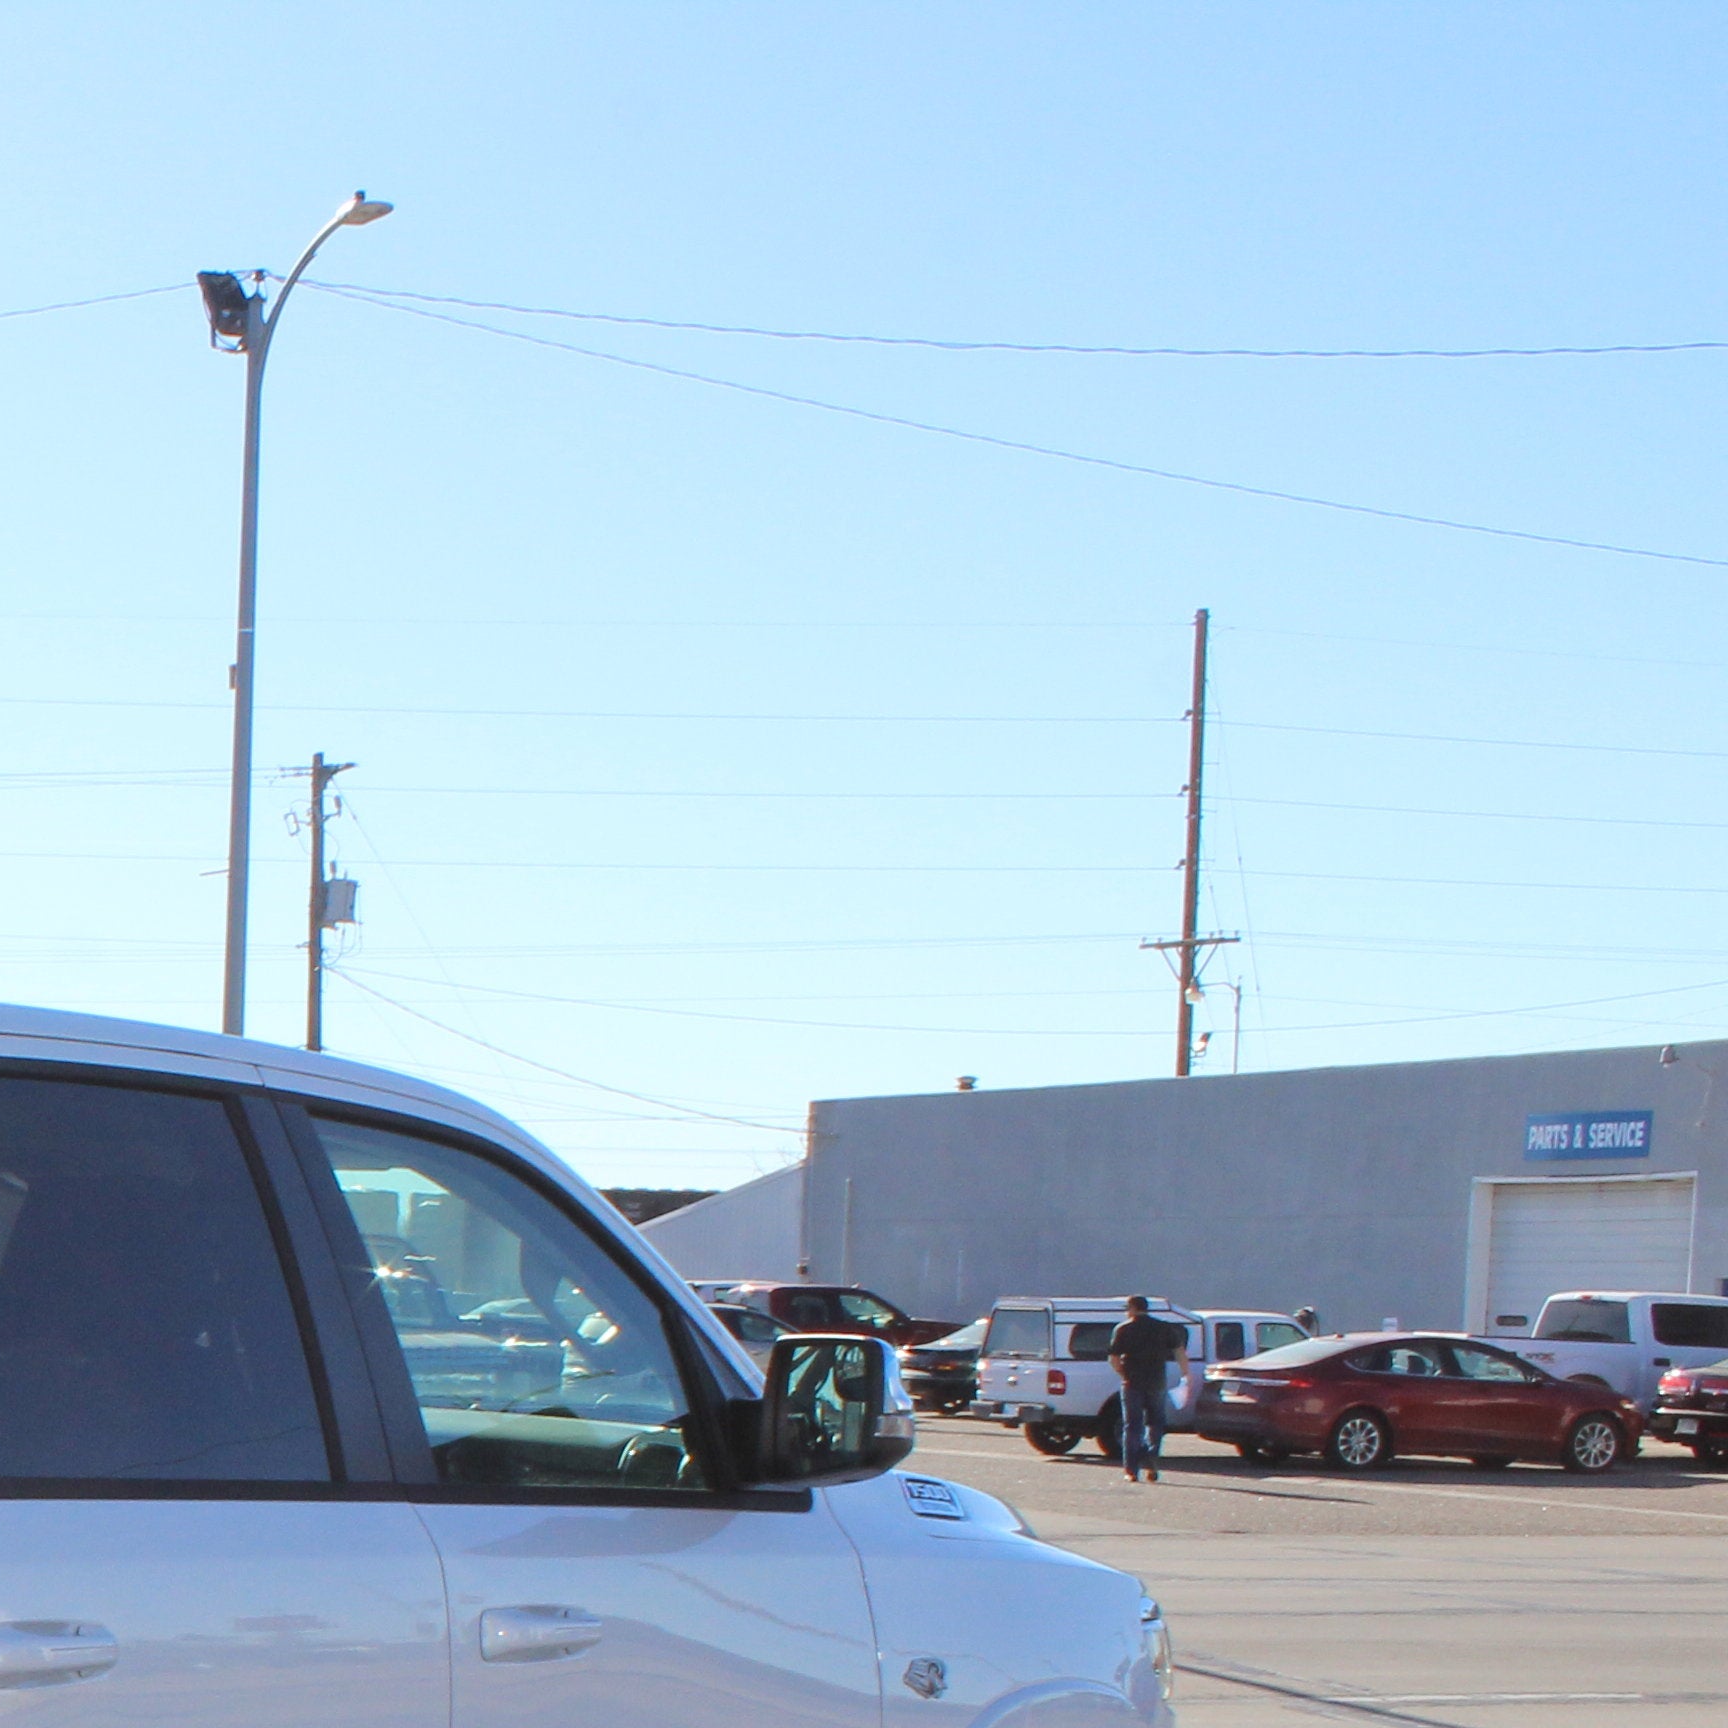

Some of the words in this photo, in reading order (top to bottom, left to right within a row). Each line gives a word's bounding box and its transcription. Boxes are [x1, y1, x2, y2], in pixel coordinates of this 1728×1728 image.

[1528, 1124, 1569, 1150] PARTS
[1573, 1122, 1585, 1149] &
[1588, 1120, 1644, 1149] SERVICE
